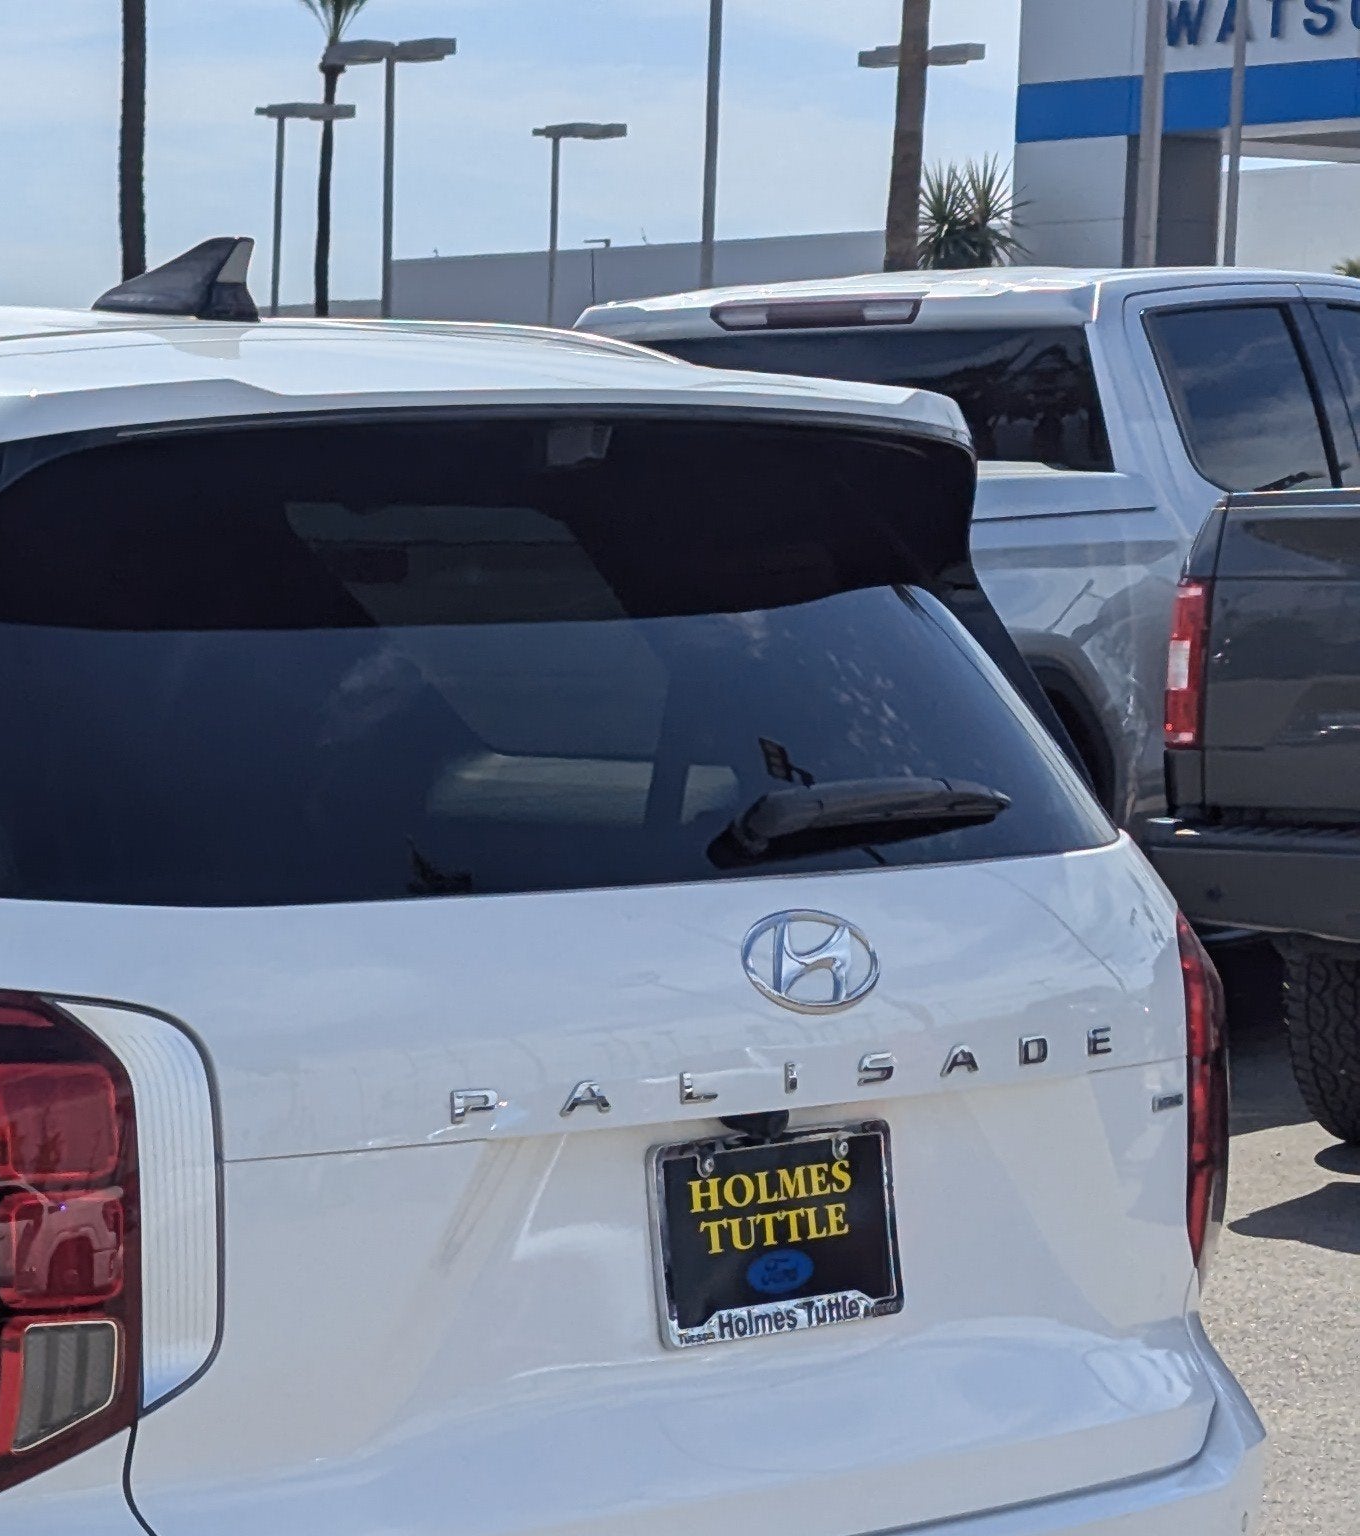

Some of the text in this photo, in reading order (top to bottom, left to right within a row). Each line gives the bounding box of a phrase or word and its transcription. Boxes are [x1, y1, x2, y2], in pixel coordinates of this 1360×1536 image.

[1166, 0, 1360, 46] WATS
[450, 1025, 1114, 1125] PALISADE
[687, 1158, 853, 1214] HOLMES
[698, 1202, 851, 1256] TUTTLE
[718, 1308, 799, 1340] Holmes
[800, 1294, 861, 1328] Tuttle
